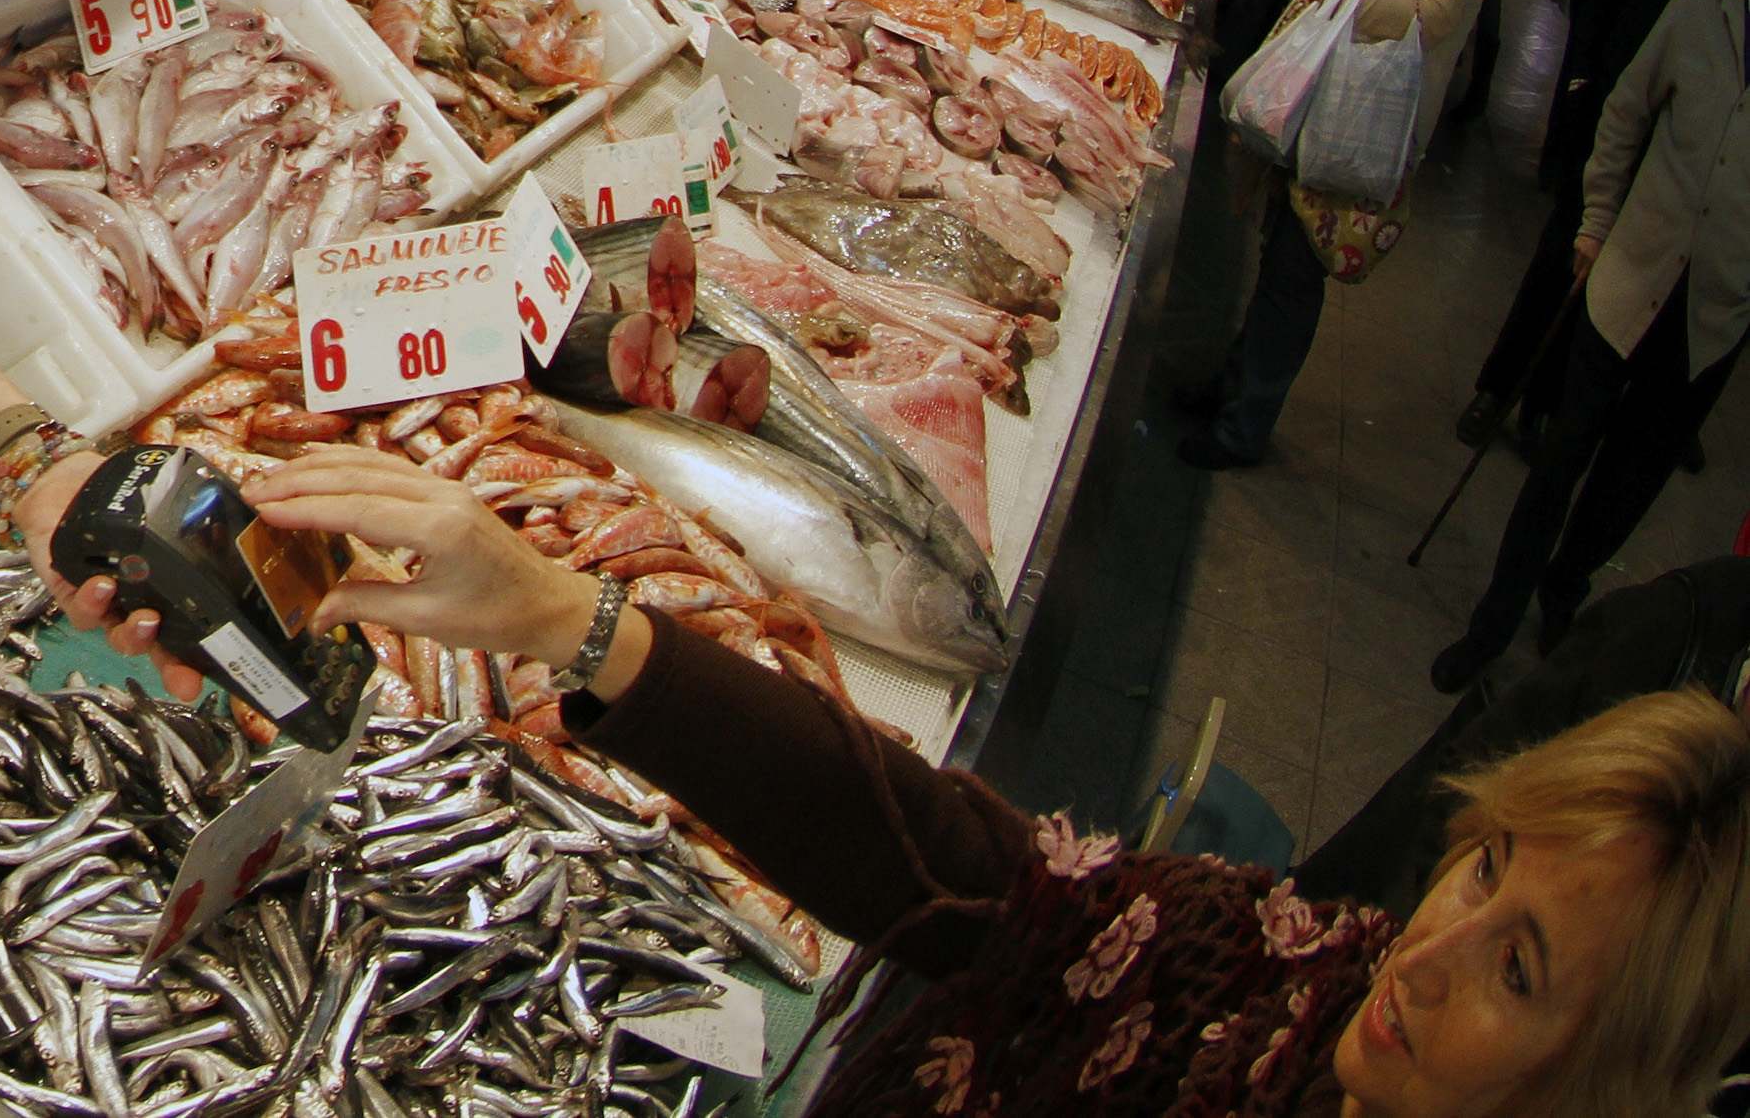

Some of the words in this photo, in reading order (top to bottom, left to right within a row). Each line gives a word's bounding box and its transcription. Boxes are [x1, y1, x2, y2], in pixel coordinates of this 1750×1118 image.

[374, 264, 494, 298] FRESCO
[310, 318, 348, 393] 6
[397, 328, 447, 381] 80
